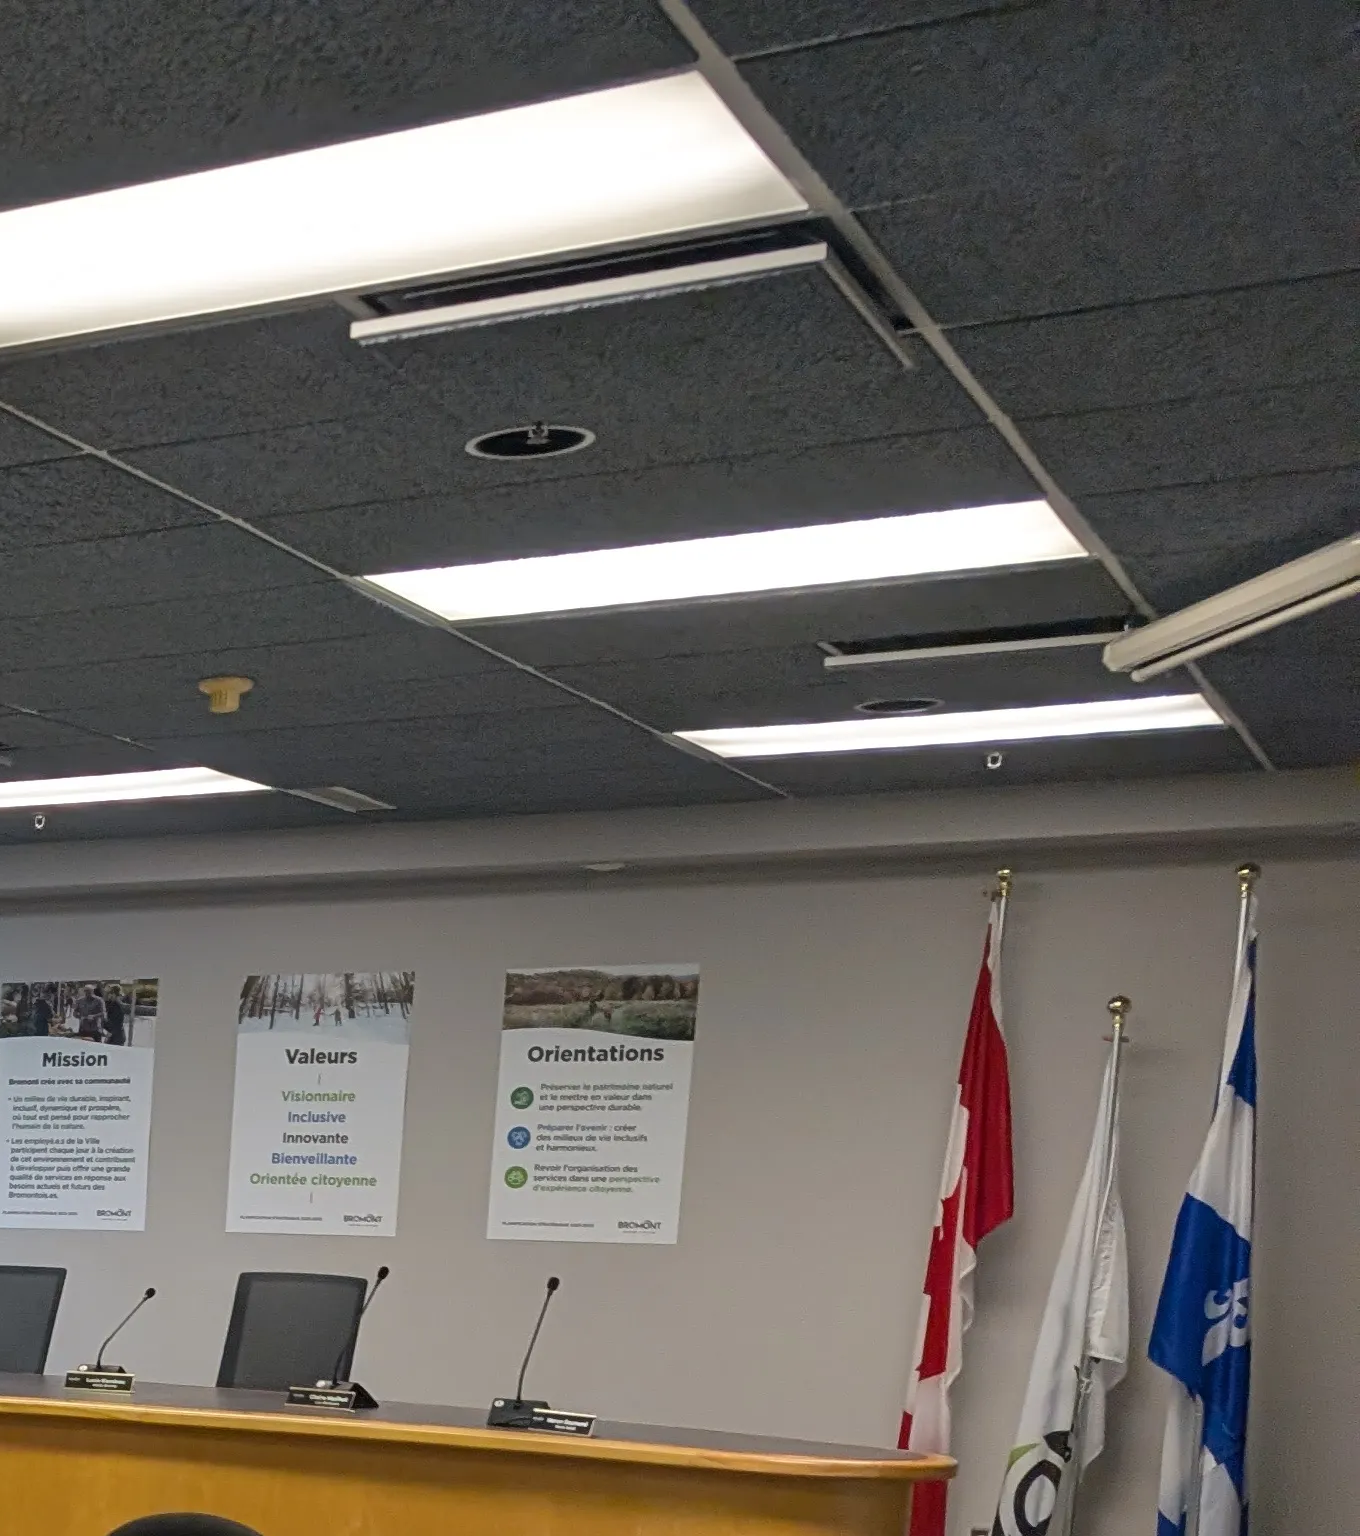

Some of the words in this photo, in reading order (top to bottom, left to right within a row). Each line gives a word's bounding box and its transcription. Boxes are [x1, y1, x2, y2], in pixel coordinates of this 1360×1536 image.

[285, 1048, 358, 1064] Valeurs
[527, 1045, 664, 1062] Orientations
[42, 1052, 107, 1067] Mission
[281, 1090, 356, 1102] Visionnaire
[556, 1104, 606, 1112] perspective
[288, 1111, 347, 1123] Inclusive
[537, 1124, 573, 1132] Préparer
[282, 1132, 349, 1144] Innovante
[271, 1153, 357, 1165] Bienveillante
[534, 1164, 561, 1172] Revoir
[563, 1165, 620, 1173] l'organisation
[623, 1164, 638, 1172] des
[250, 1172, 307, 1185] Orientée
[311, 1174, 377, 1187] citoyenne
[609, 1176, 660, 1184] perspective
[533, 1185, 586, 1193] d'expérience
[96, 1208, 132, 1217] BROMONT
[343, 1213, 383, 1223] BROMONT
[618, 1220, 661, 1230] BROMONT
